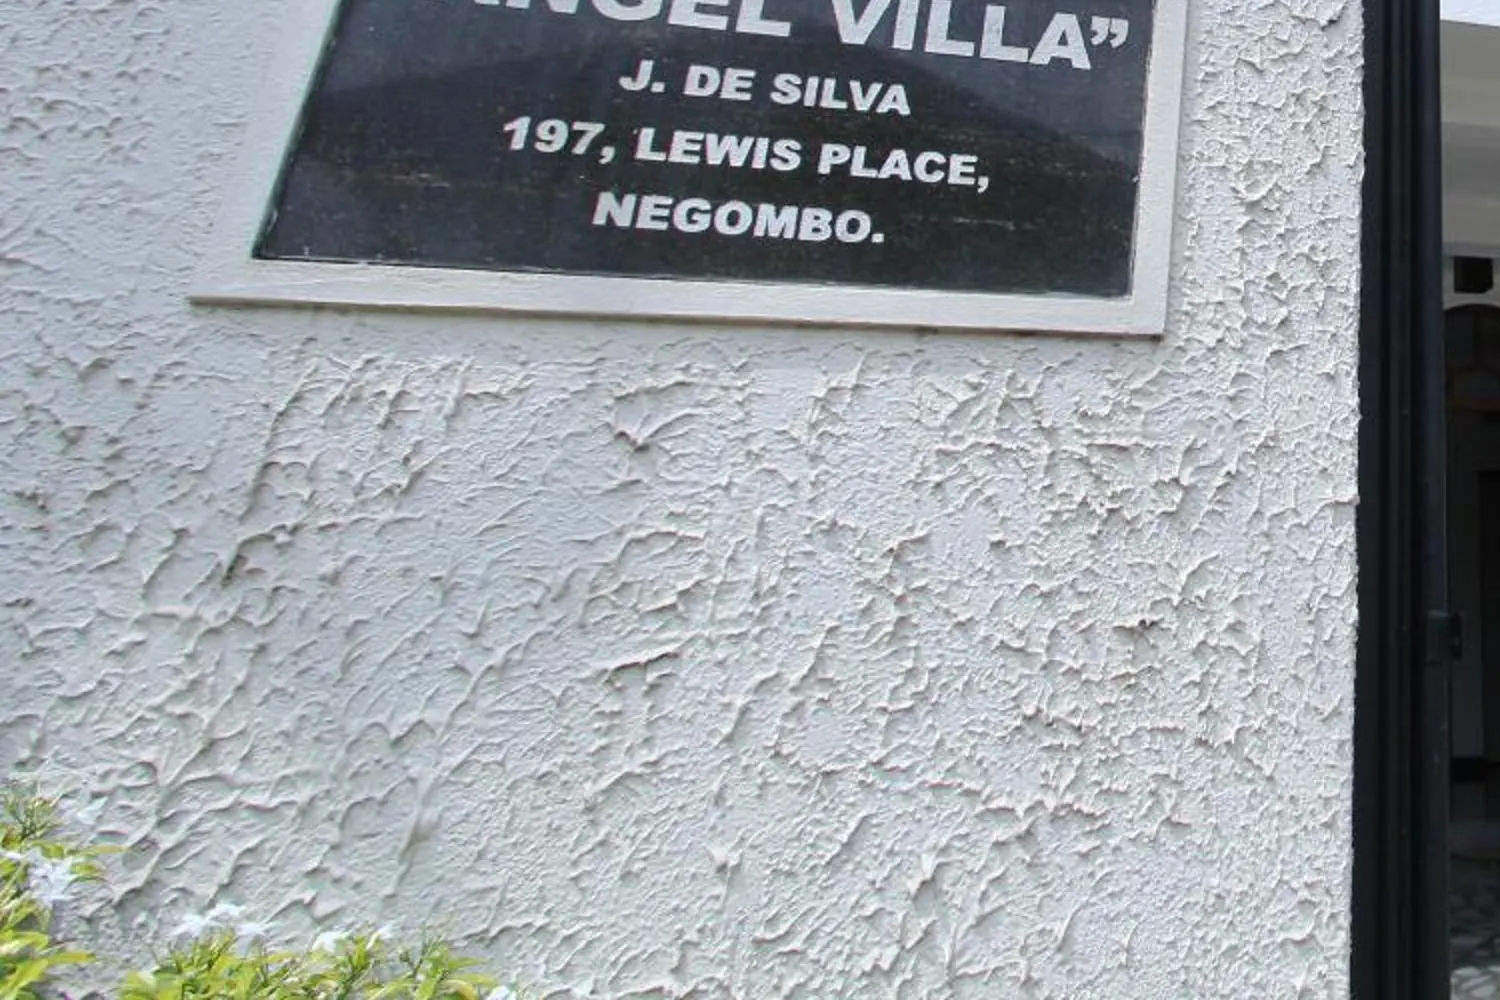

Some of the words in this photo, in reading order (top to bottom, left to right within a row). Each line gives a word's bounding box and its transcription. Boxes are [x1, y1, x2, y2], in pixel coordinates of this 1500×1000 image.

[619, 59, 664, 93] J.
[683, 64, 756, 101] DE
[769, 73, 911, 116] SILVA
[503, 116, 614, 165] 197,
[633, 127, 802, 172] LEWIS
[817, 143, 990, 194] PLACE,
[591, 191, 885, 244] NEGOMBO.
